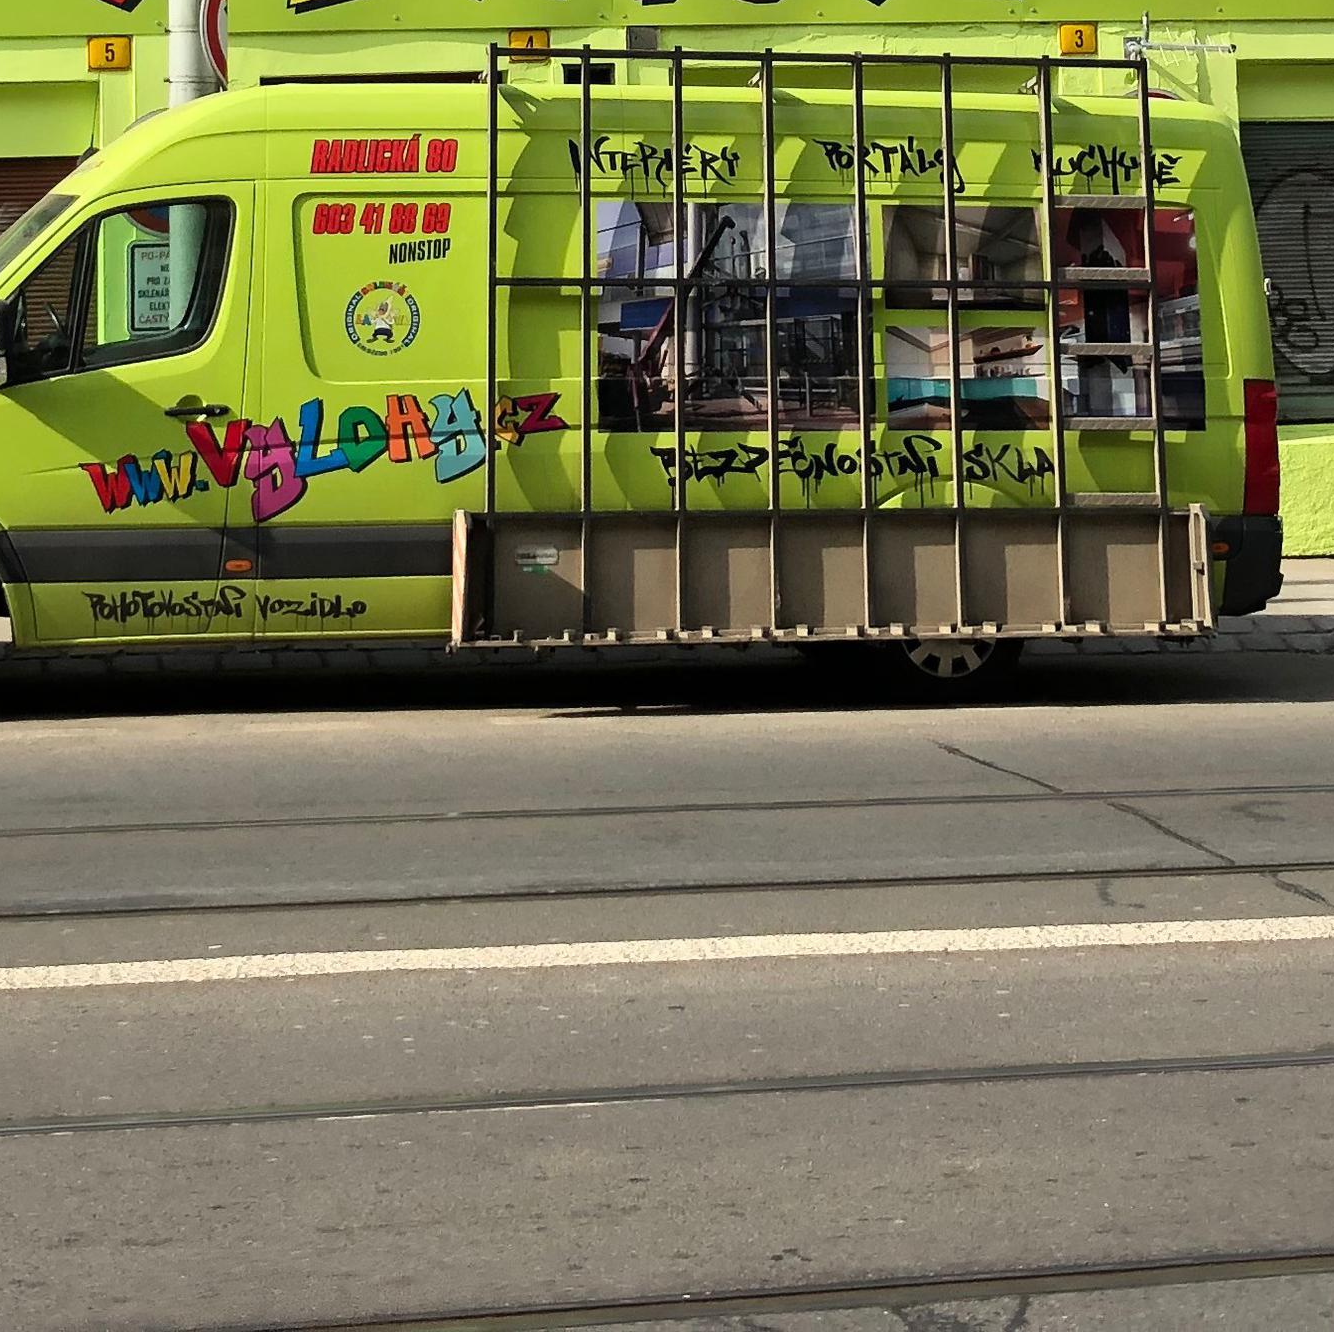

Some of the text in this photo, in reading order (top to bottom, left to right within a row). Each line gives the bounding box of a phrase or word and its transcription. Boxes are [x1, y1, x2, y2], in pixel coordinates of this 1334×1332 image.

[1072, 29, 1084, 48] 3
[104, 43, 115, 63] 5
[310, 133, 459, 173] RADLICKÁ 80
[312, 203, 451, 234] 603 41 88 69
[389, 238, 451, 264] NONSTOP
[255, 592, 367, 621] VOZIDLO
